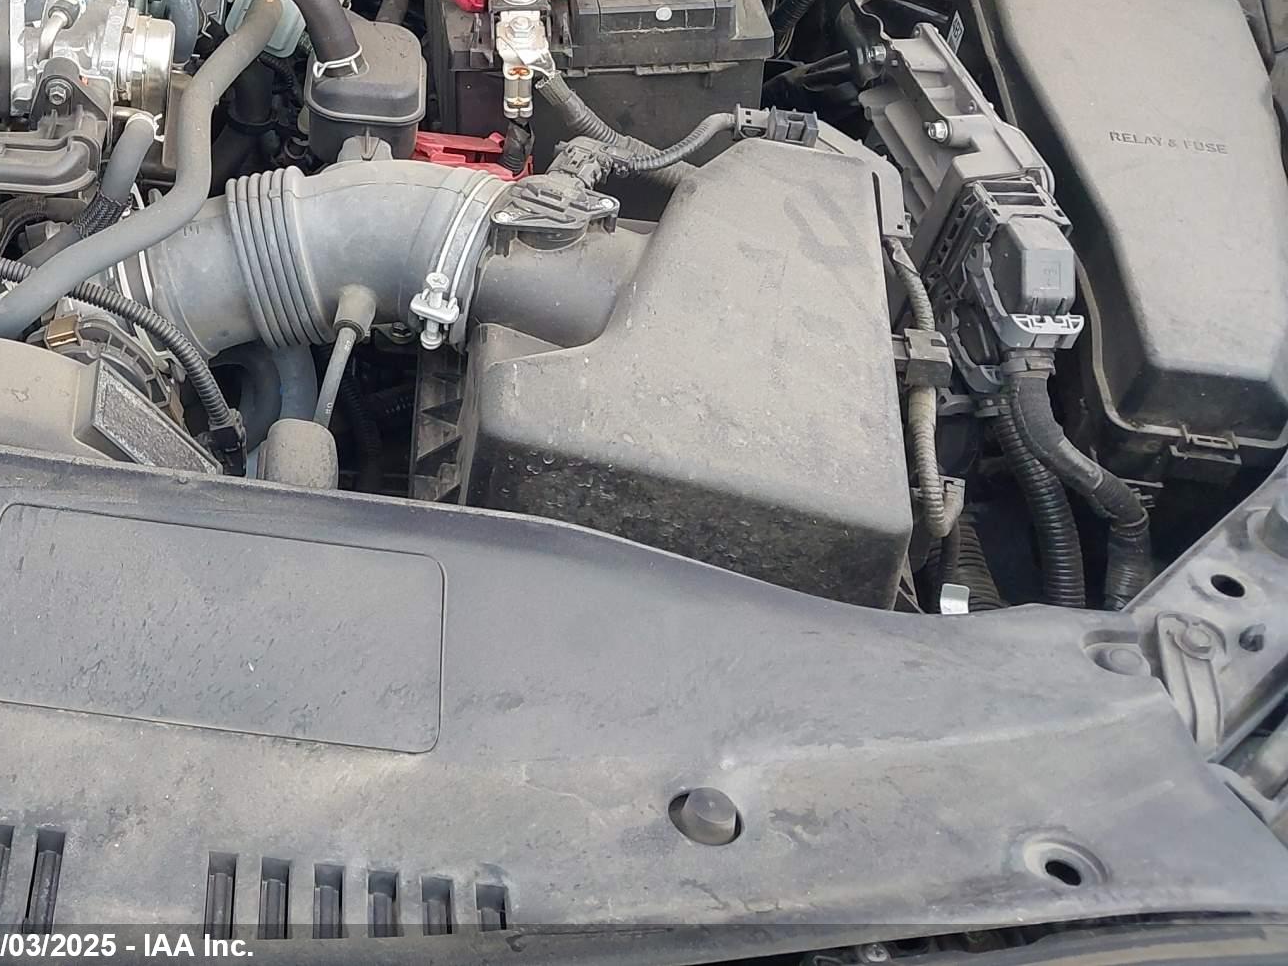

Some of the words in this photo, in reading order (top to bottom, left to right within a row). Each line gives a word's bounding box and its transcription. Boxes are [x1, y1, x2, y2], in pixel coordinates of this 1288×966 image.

[1109, 131, 1162, 146] RELAY
[1168, 138, 1177, 148] &
[1184, 139, 1228, 154] FUSE
